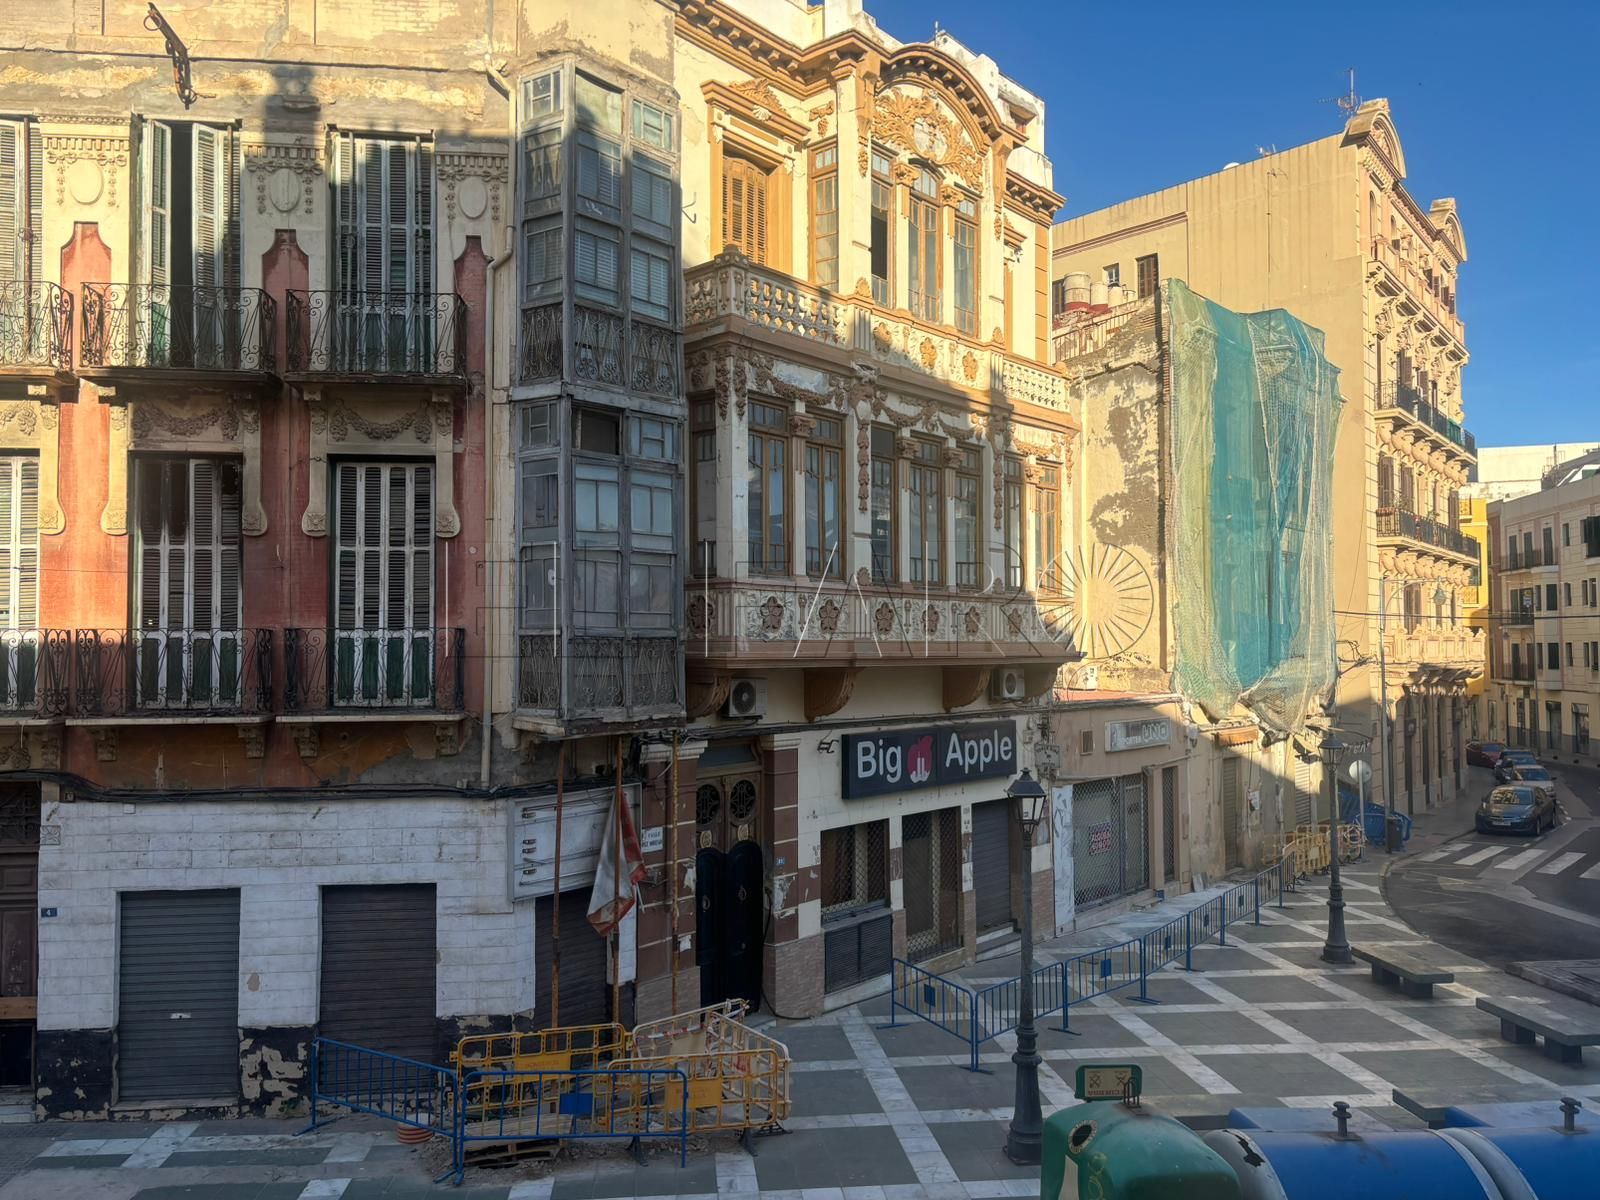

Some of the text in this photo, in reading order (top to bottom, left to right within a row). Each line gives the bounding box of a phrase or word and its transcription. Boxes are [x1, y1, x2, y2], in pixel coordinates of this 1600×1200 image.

[1142, 722, 1169, 743] UNO
[857, 738, 902, 784] Big
[945, 728, 1012, 774] Apple
